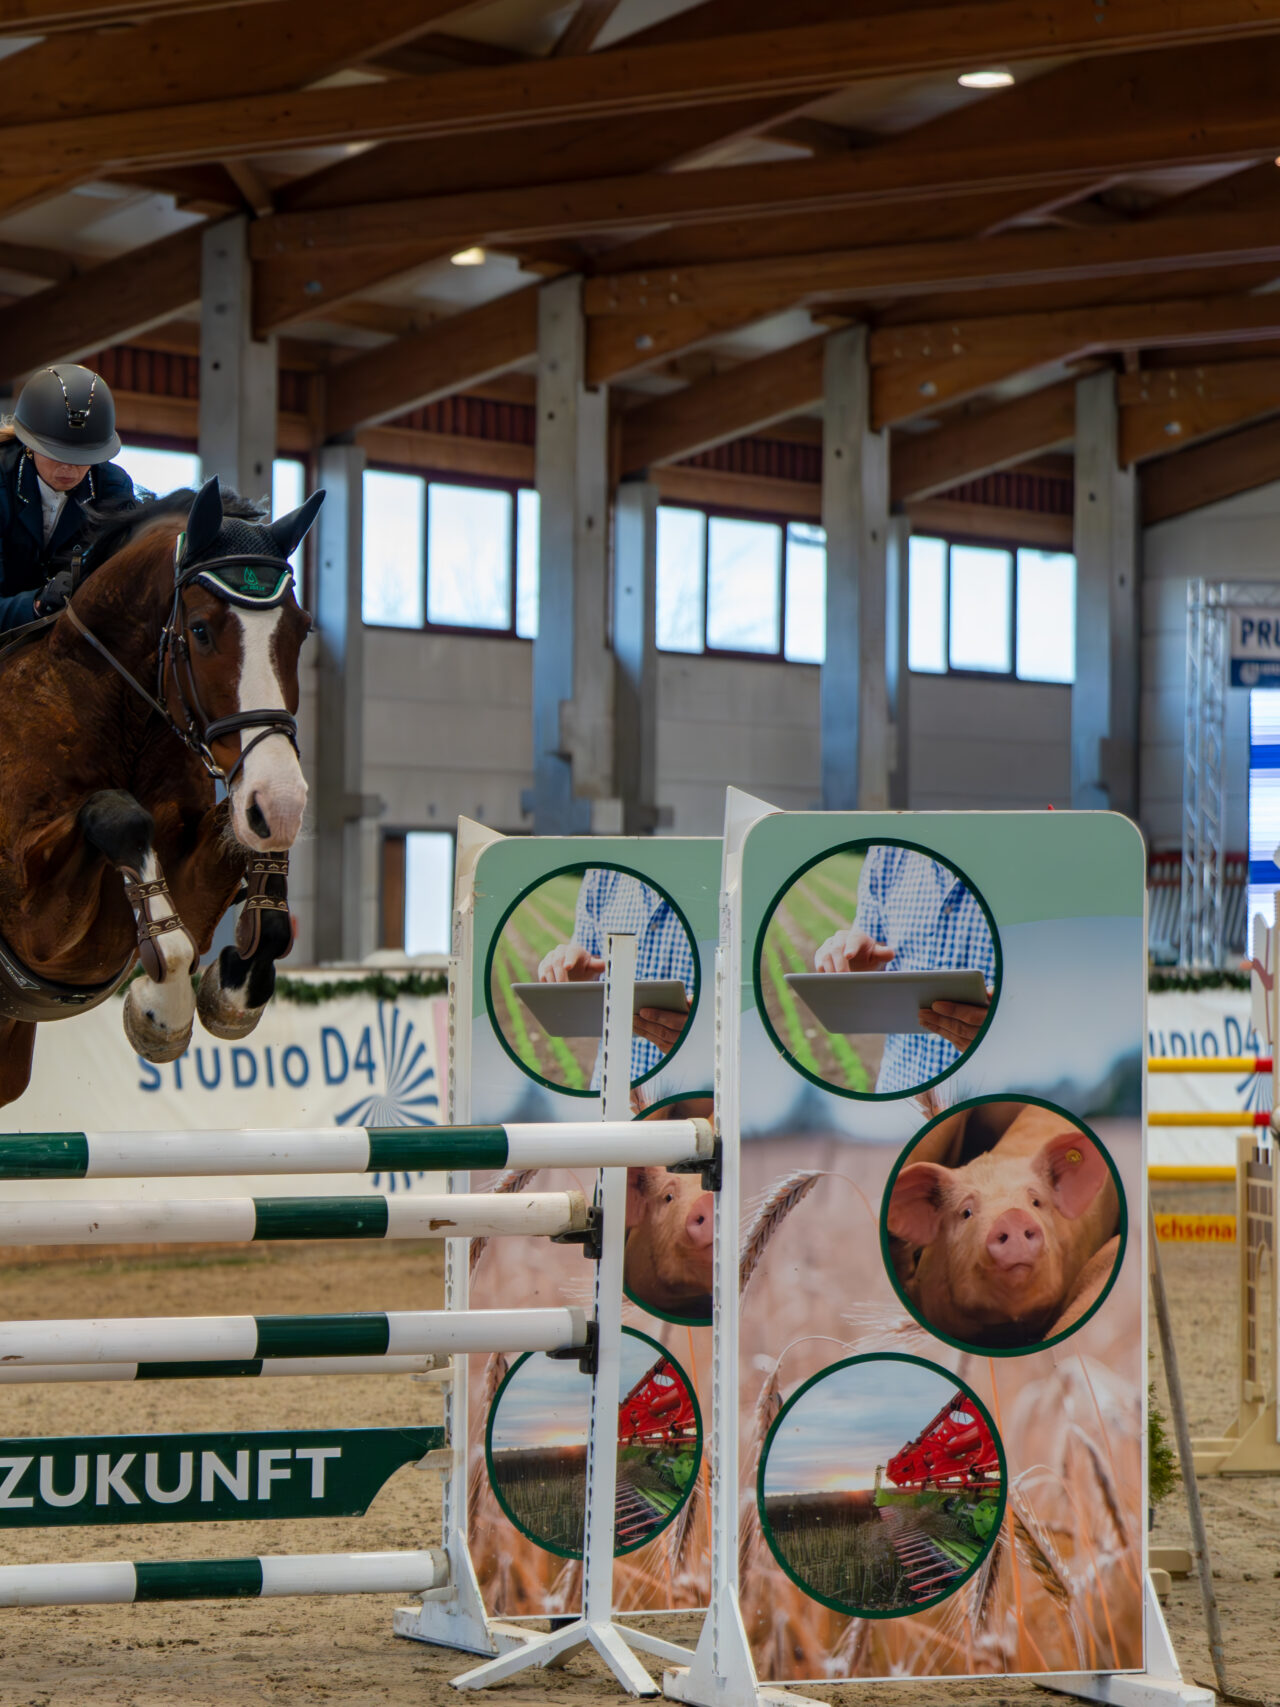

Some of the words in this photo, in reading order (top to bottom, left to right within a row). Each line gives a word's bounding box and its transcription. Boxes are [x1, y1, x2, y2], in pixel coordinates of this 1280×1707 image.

[138, 1045, 310, 1091] STUDIO
[320, 1026, 377, 1085] D4
[1148, 1030, 1219, 1057] UDIO
